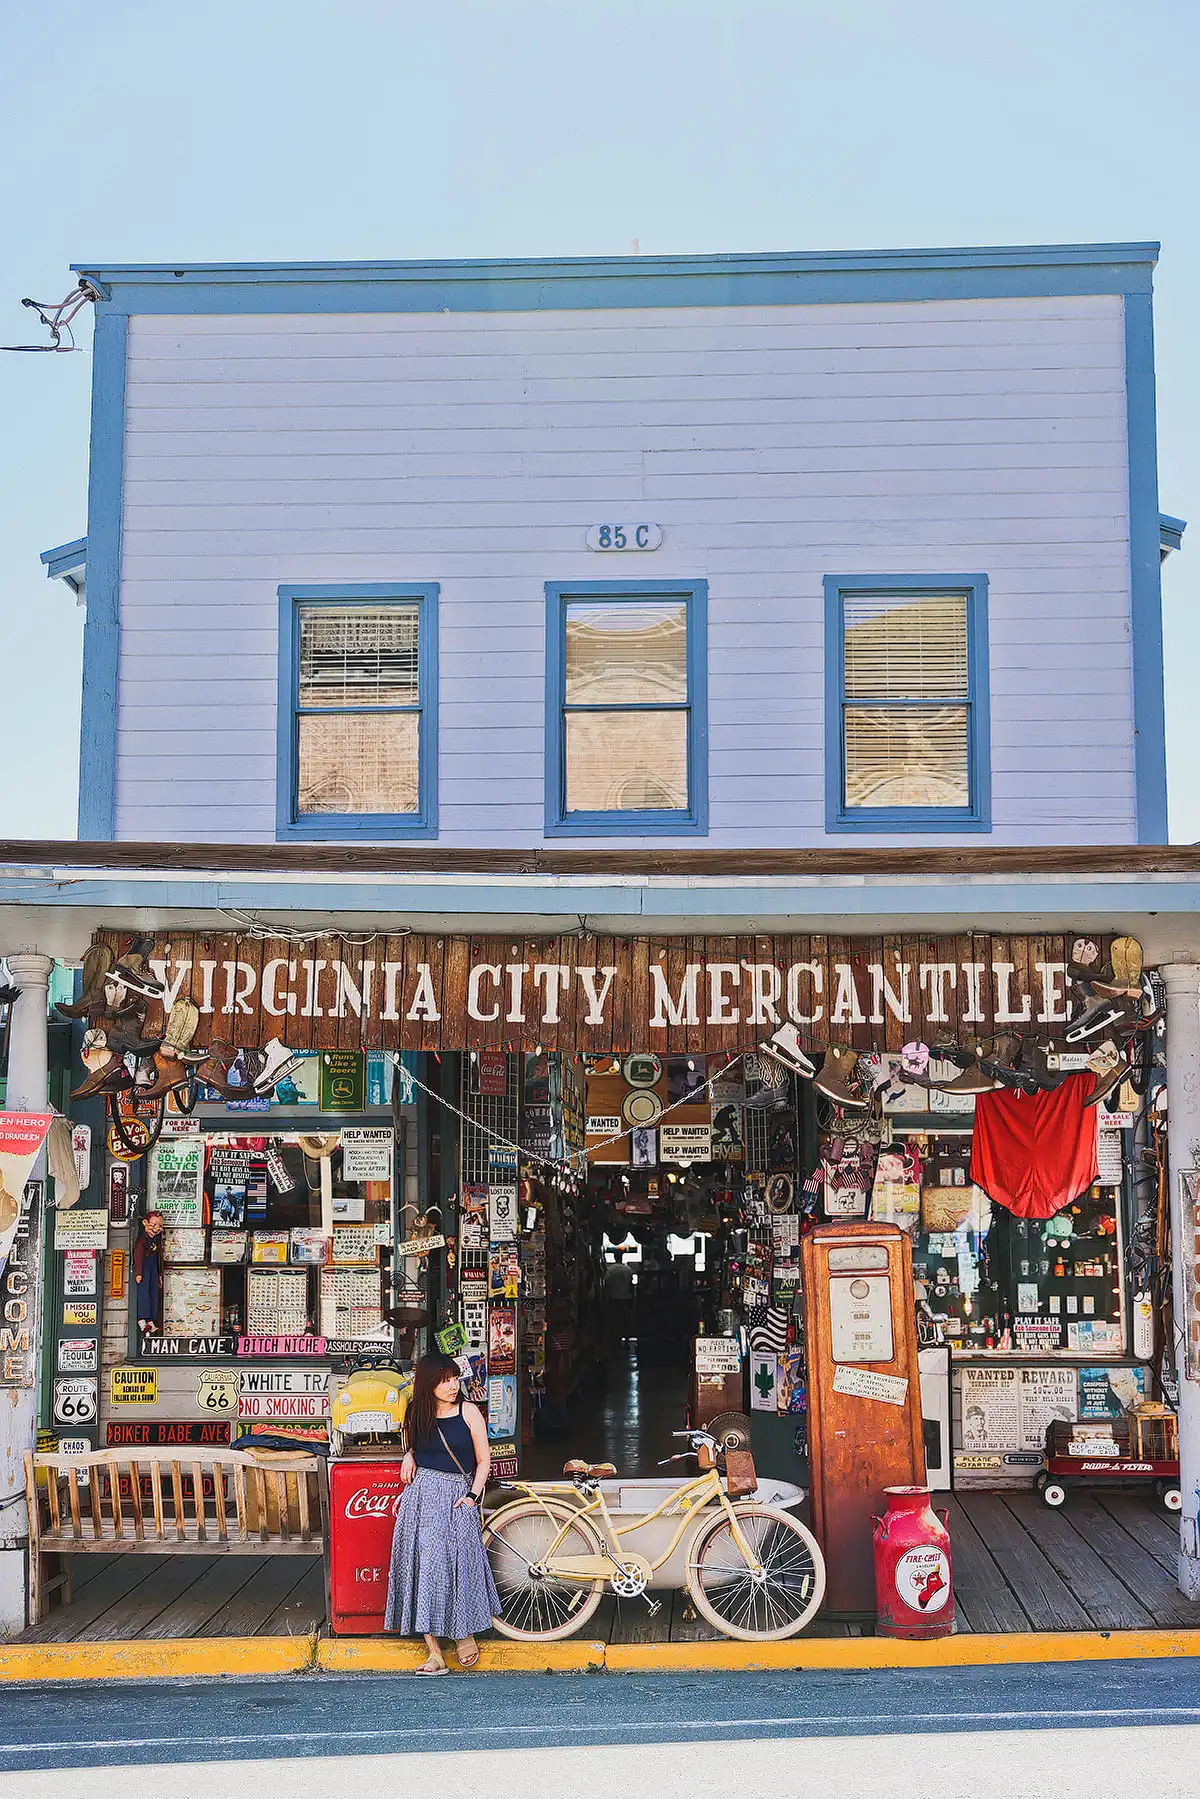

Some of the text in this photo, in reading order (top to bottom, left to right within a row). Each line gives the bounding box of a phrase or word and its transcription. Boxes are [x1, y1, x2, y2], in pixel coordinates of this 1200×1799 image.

[599, 525, 648, 548] 85 C
[148, 959, 1073, 1027] VIRGINIA CITY MERCANTILE
[525, 1108, 551, 1118] COWBO
[591, 1118, 619, 1127] WANTED
[113, 1134, 146, 1152] BST
[158, 1162, 197, 1170] CELTICS
[151, 1338, 225, 1354] MAN CAVE
[244, 1339, 319, 1352] BITCH NICHE
[328, 1341, 363, 1352] ASSHOLE'S
[62, 1352, 93, 1360] TEQUILA
[115, 1372, 154, 1383] CAUTION
[967, 1370, 1014, 1380] WANTED
[1022, 1370, 1073, 1384] REWARD
[247, 1375, 296, 1390] WHITE
[62, 1396, 90, 1417] 66
[207, 1393, 229, 1407] 66
[244, 1399, 259, 1415] NO
[266, 1398, 315, 1415] SMOKING
[114, 1426, 149, 1442] BIKER
[158, 1425, 192, 1441] BABE
[201, 1425, 224, 1441] AVE
[500, 1461, 515, 1475] WAY
[1120, 1463, 1153, 1471] FLYER
[355, 1567, 382, 1583] ICE
